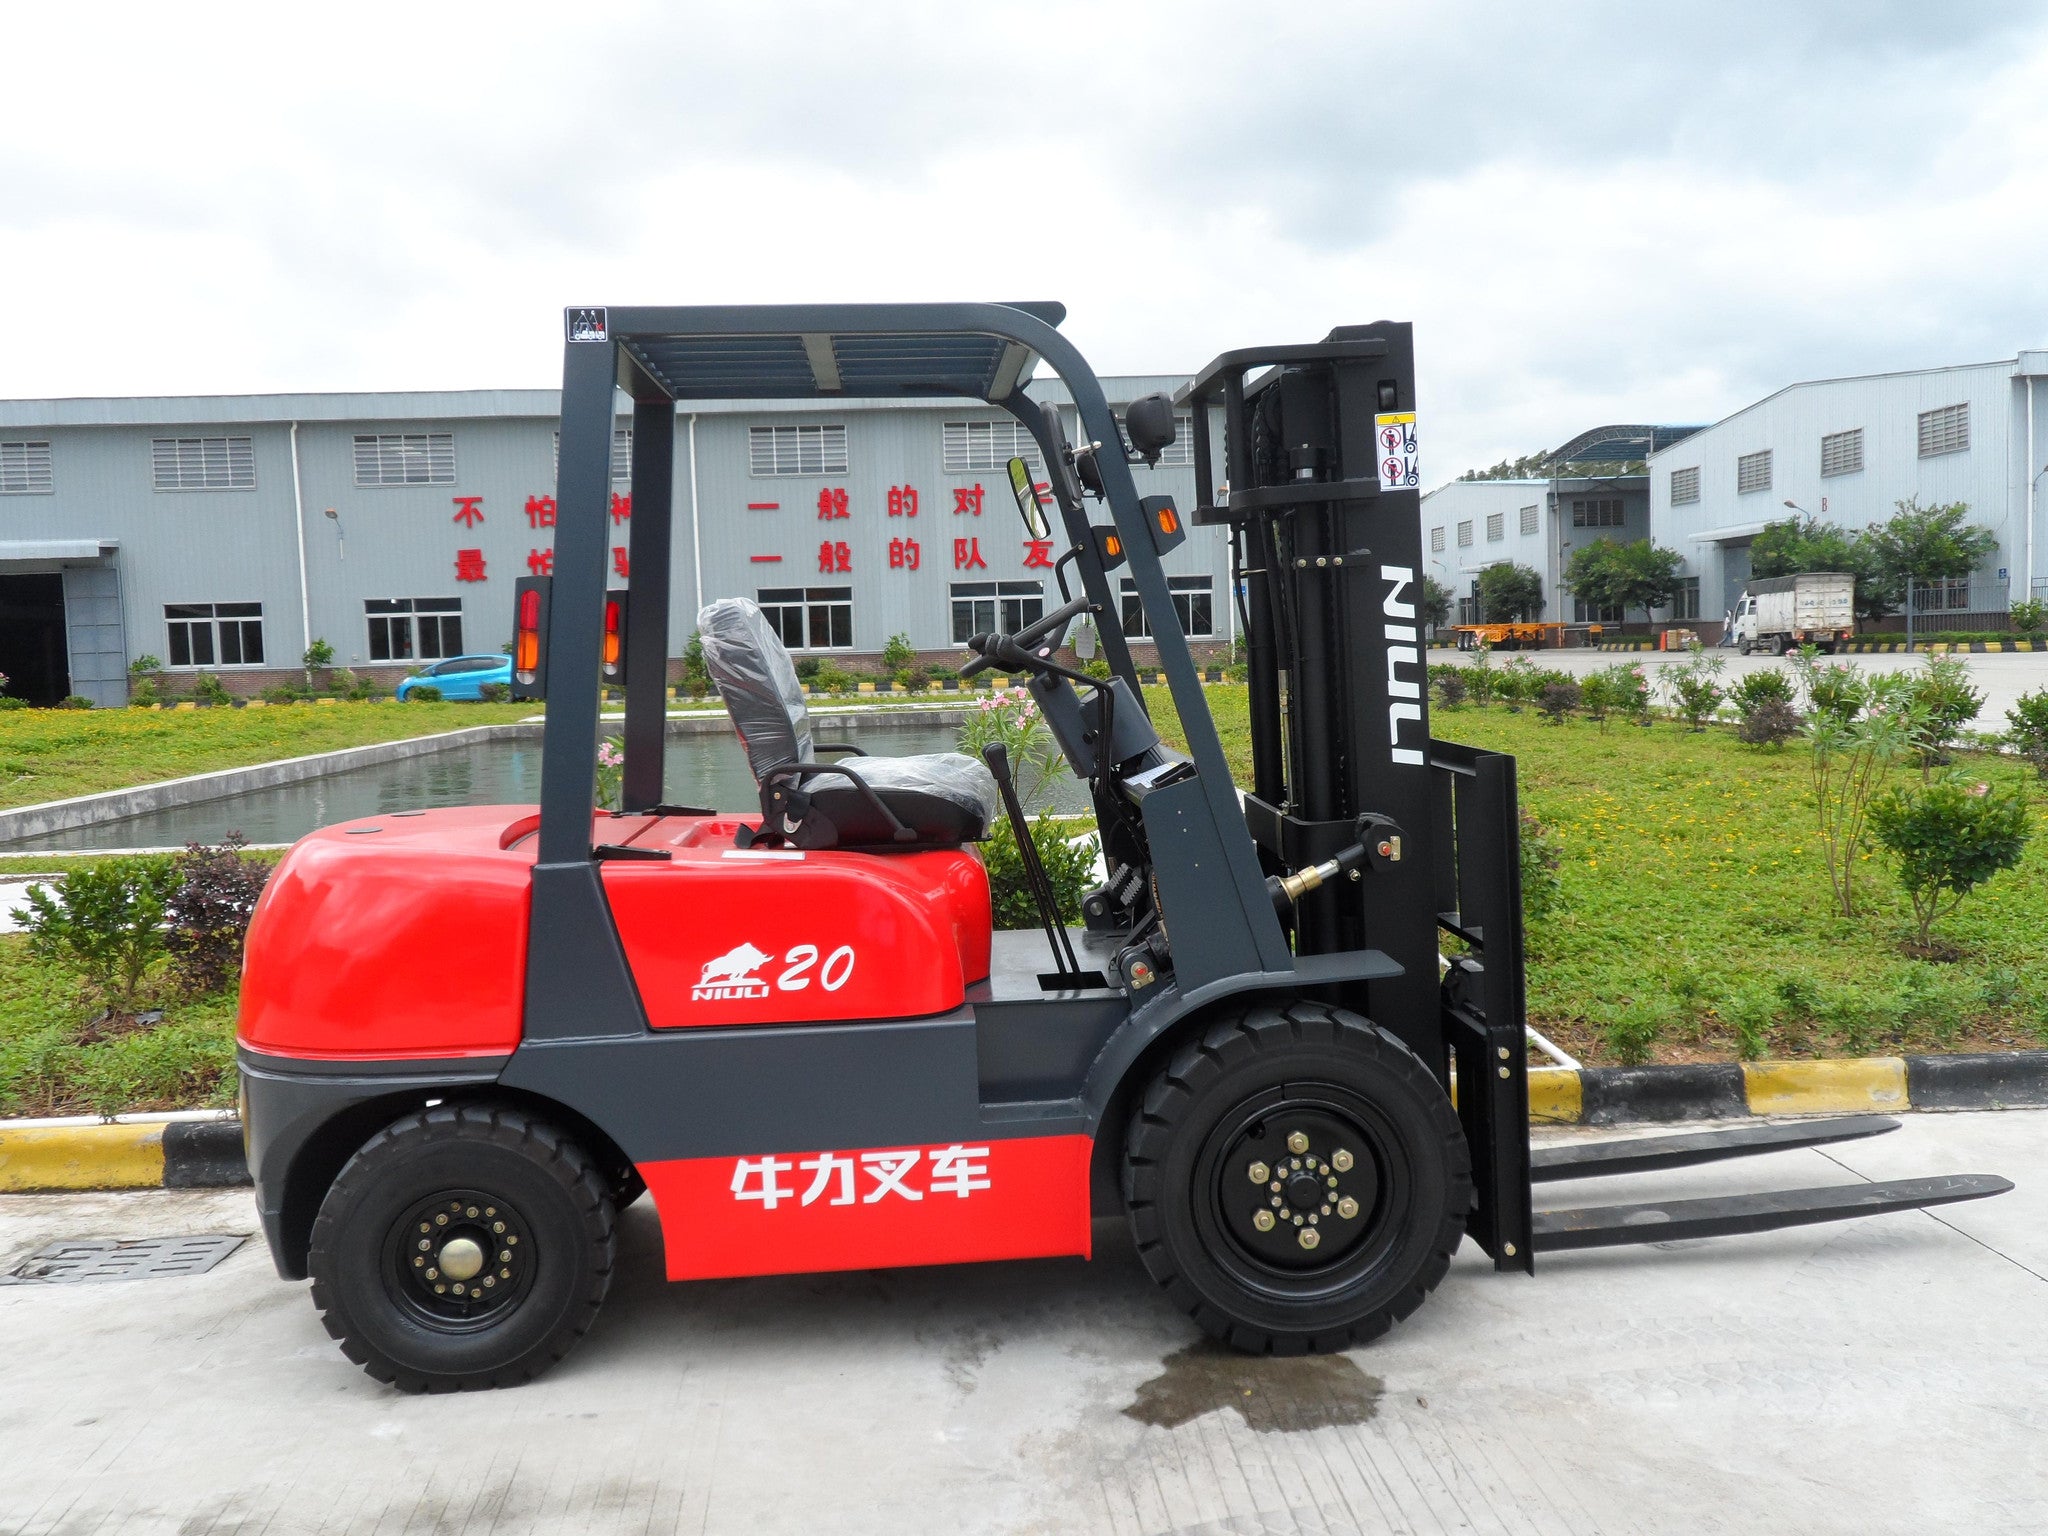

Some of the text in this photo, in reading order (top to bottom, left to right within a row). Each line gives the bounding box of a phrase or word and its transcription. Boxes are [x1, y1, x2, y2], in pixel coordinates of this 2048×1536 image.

[1380, 565, 1424, 766] NIULI
[692, 985, 770, 1001] NIULI
[777, 944, 855, 991] 20
[730, 1145, 991, 1209] 牛力叉车
